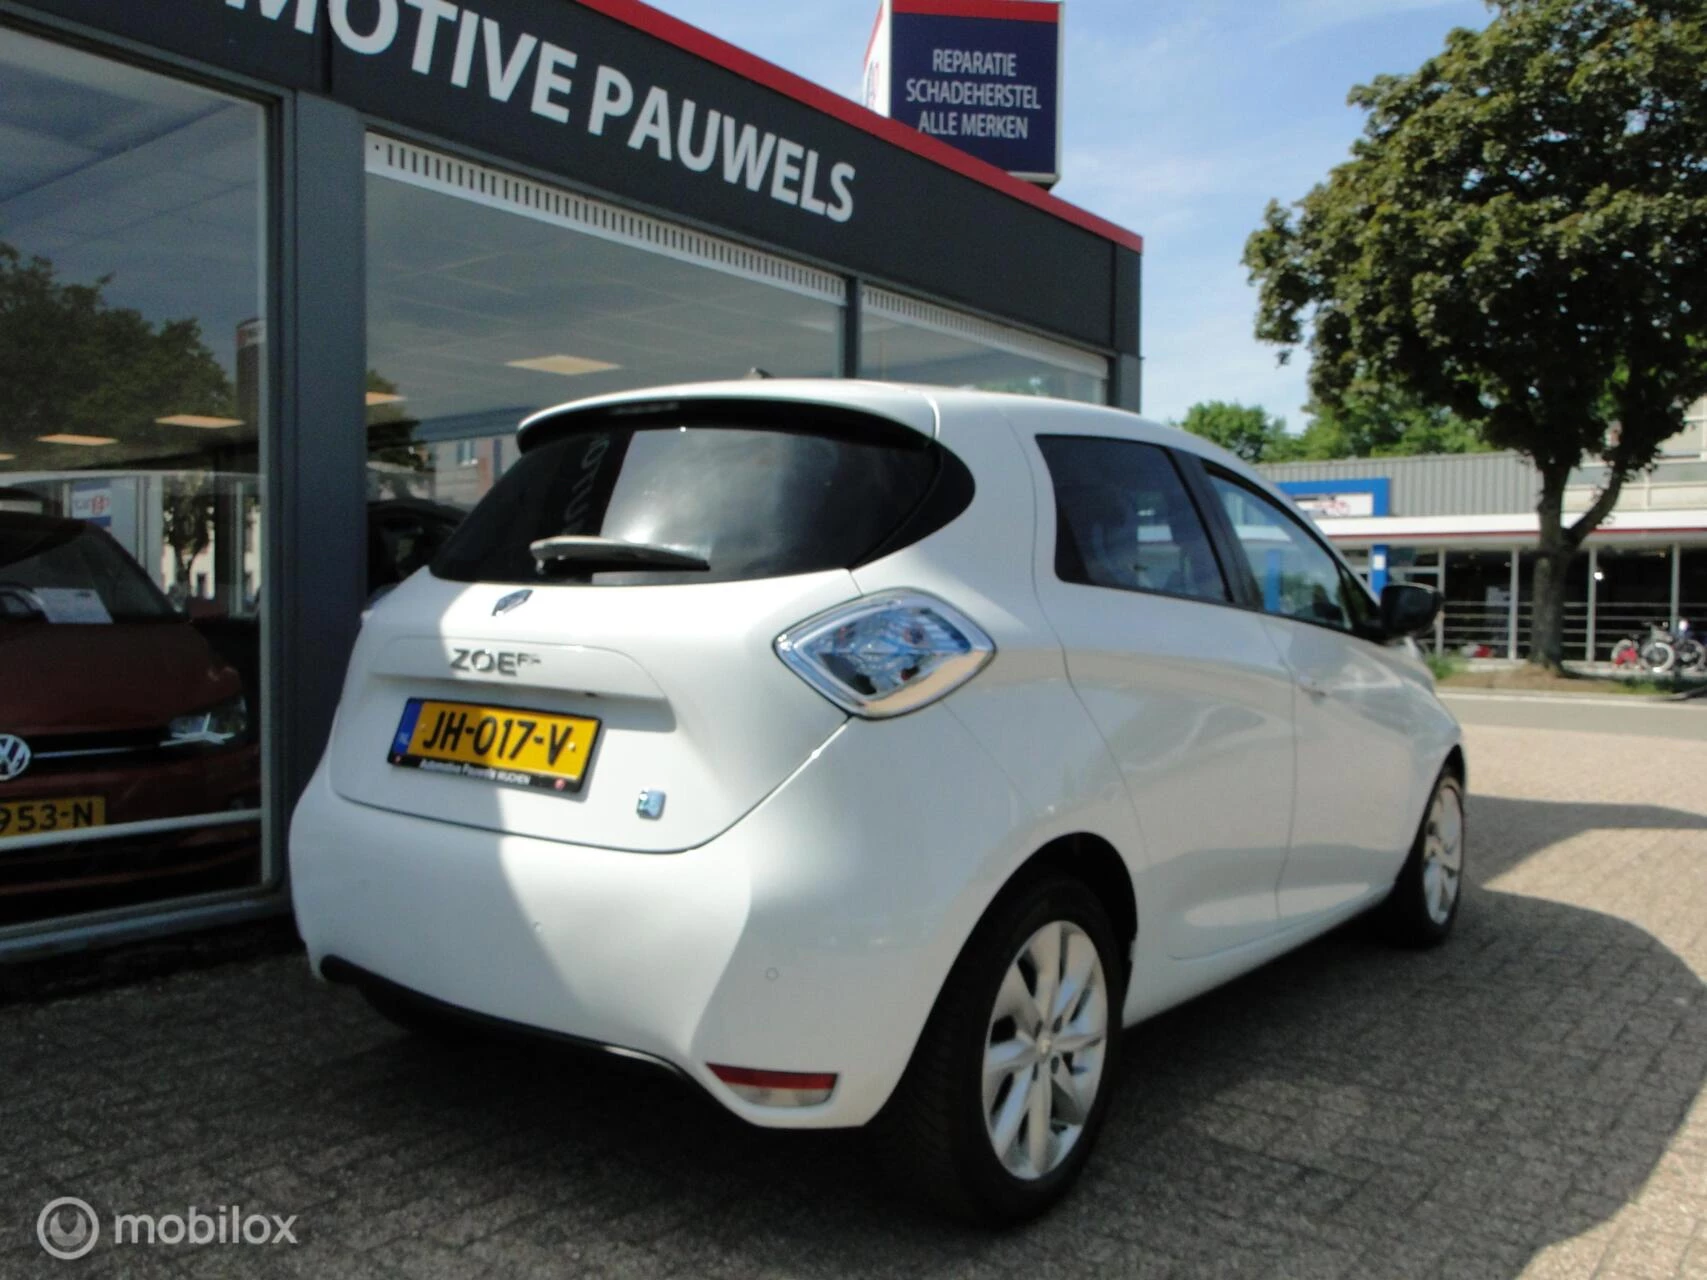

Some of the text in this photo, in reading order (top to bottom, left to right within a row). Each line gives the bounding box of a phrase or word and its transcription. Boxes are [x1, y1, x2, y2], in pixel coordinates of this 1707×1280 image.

[933, 49, 1017, 77] REPARATIE
[906, 78, 1041, 109] SCHADEHERSTEL
[918, 110, 1028, 139] ALLE MERKEN
[588, 65, 855, 222] PAUWELS
[450, 648, 517, 676] ZOE
[422, 710, 573, 765] JH-017-V
